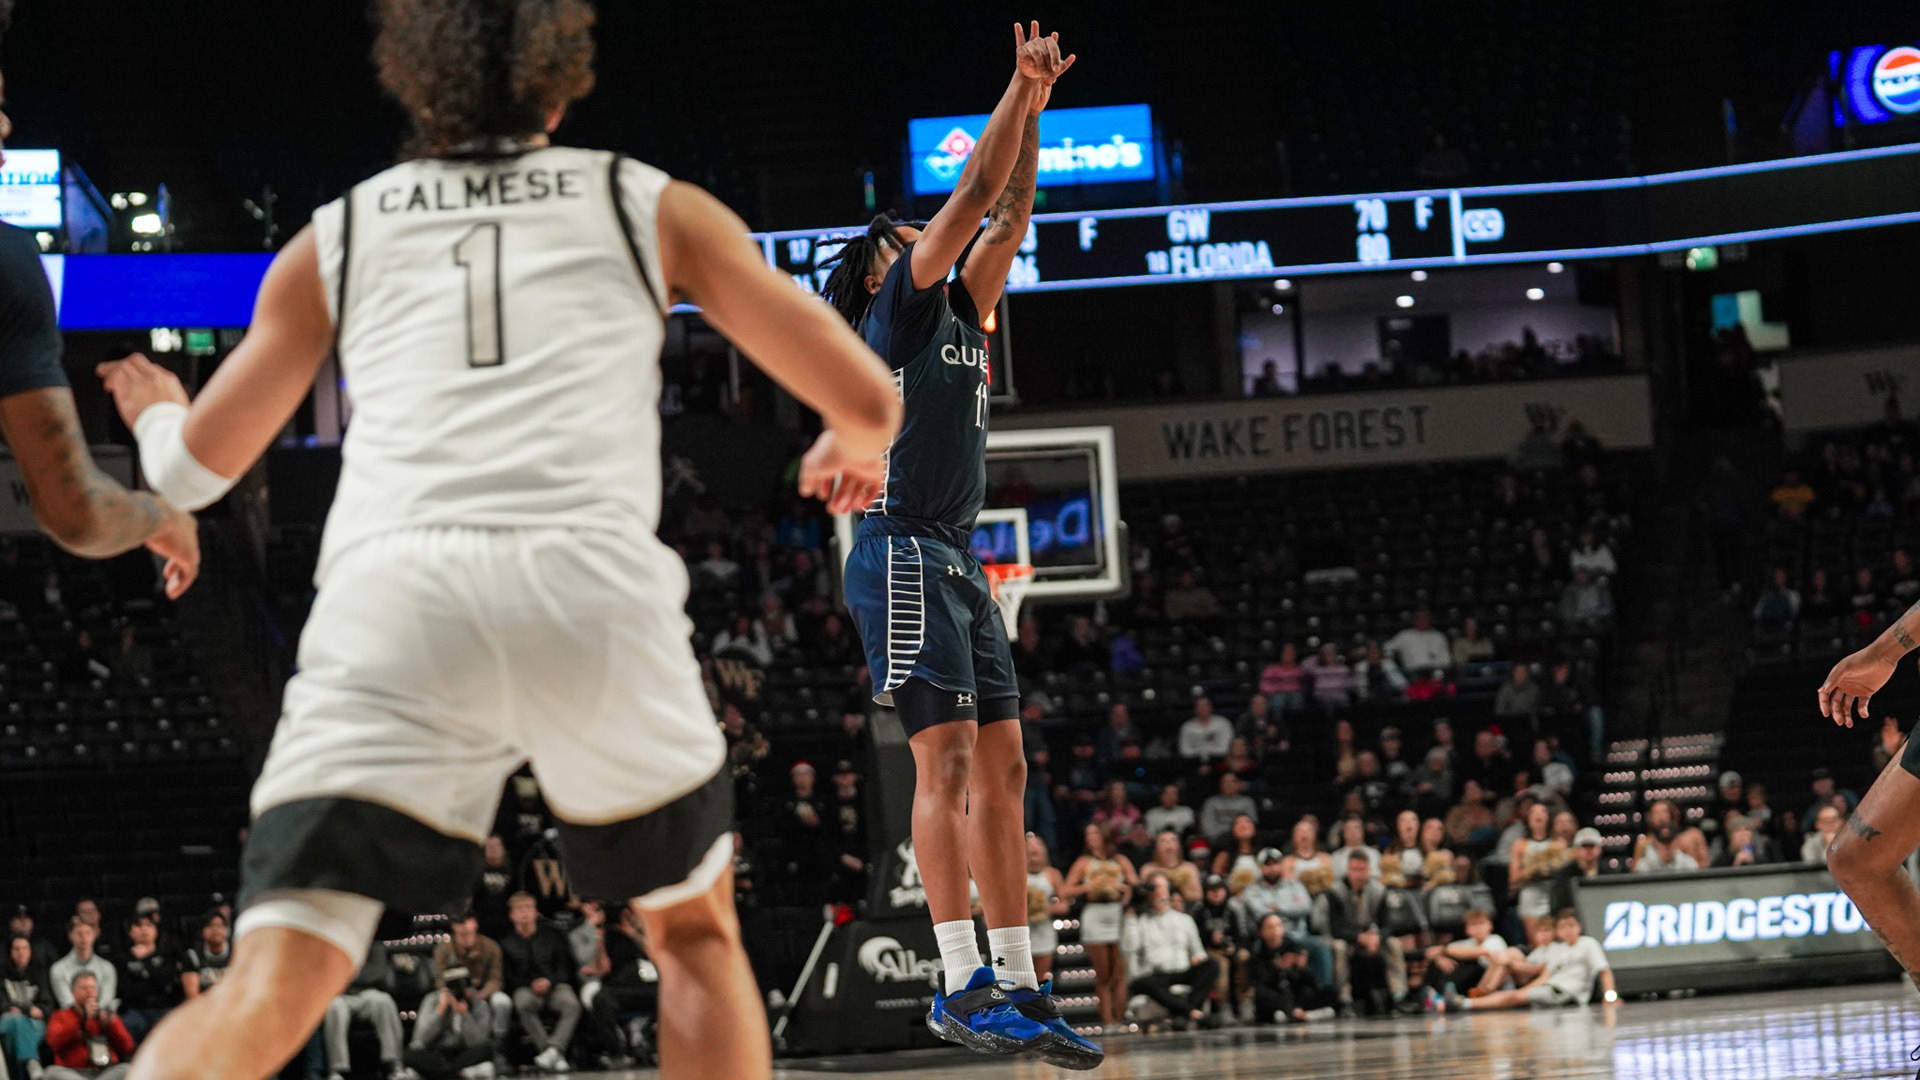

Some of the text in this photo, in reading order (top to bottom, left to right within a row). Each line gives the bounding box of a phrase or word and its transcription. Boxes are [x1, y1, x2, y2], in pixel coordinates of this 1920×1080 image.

[1038, 133, 1143, 172] mino's
[378, 168, 583, 214] CALMESE
[1167, 208, 1211, 244] GW
[1354, 198, 1388, 232] 70
[1414, 195, 1434, 231] F
[1079, 216, 1098, 251] F
[1170, 240, 1275, 278] FLORIDA
[453, 220, 505, 368] 1
[940, 343, 989, 373] QUE
[1162, 403, 1430, 460] WAKE FOREST
[1603, 890, 1873, 950] BRIDGESTO
[868, 942, 943, 989] Alleg
